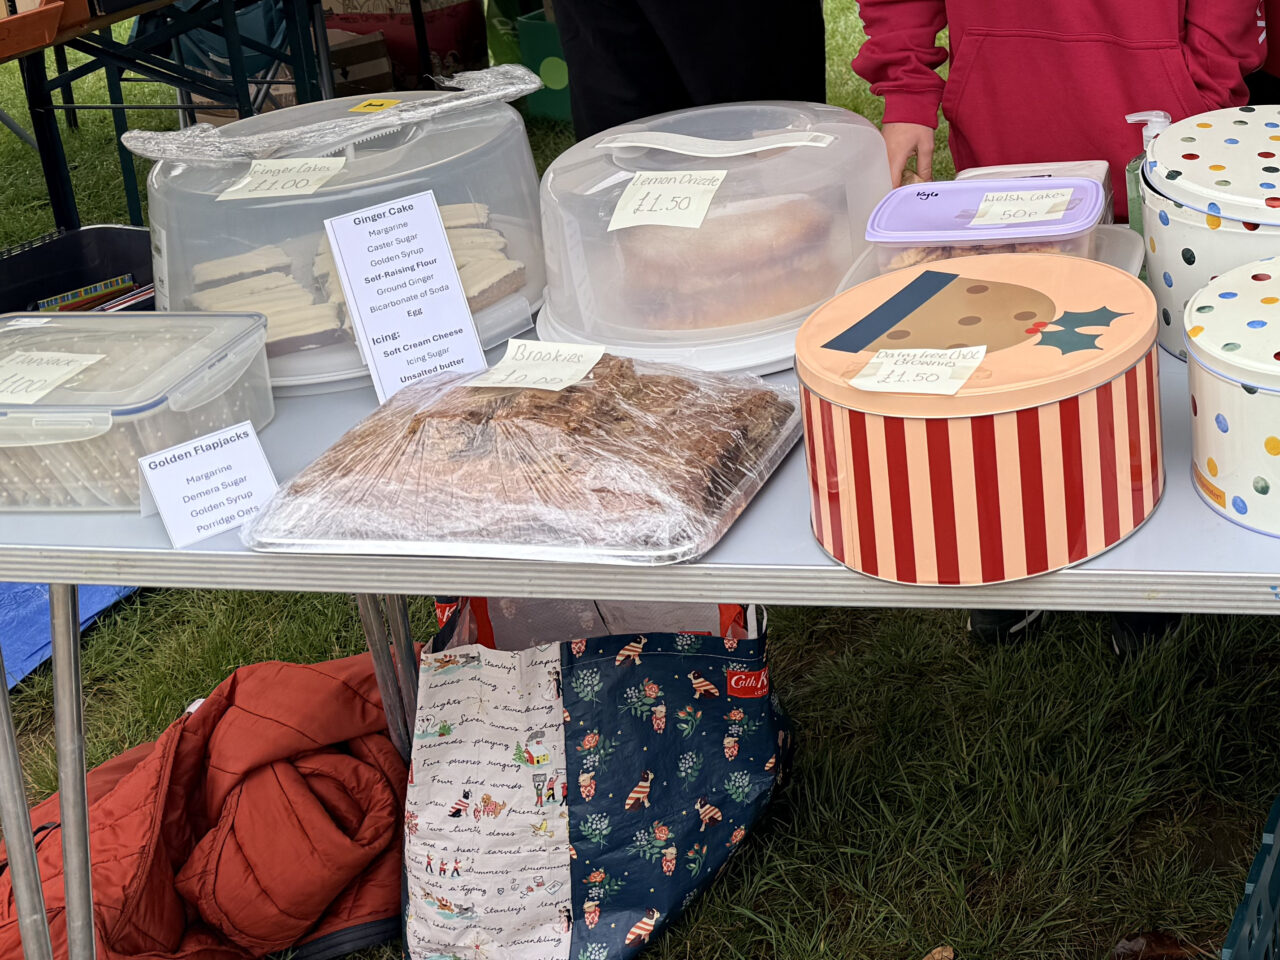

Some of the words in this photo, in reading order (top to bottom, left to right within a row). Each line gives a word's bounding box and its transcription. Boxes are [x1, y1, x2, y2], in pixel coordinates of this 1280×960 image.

[632, 173, 677, 187] Lemon
[353, 211, 387, 226] Ginger
[388, 203, 414, 216] Cake
[632, 191, 692, 215] £1.50
[368, 220, 409, 238] Margarine
[367, 239, 394, 253] Caster
[395, 232, 418, 246] Sugar
[370, 253, 400, 267] Golden
[400, 246, 425, 261] Syrup
[364, 263, 416, 285] Self-Raising
[416, 256, 438, 270] Flour
[376, 282, 407, 296] Ground
[408, 273, 434, 288] Ginger
[369, 293, 419, 314] Bicarbonate
[419, 289, 428, 299] of
[428, 283, 450, 297] Soda
[406, 306, 424, 318] Egg
[371, 330, 400, 346] Icing:
[383, 346, 402, 358] Soft
[402, 337, 431, 353] Cream
[432, 327, 464, 343] Cheese
[406, 353, 427, 366] Icing
[427, 345, 450, 360] Sugar
[512, 343, 584, 364] Brookies
[399, 365, 438, 384] Unsalted
[439, 356, 465, 371] butter
[877, 369, 940, 384] £1.50
[148, 449, 193, 471] Golden
[193, 428, 250, 457] Flapjacks
[185, 462, 233, 485] Margarine
[182, 485, 220, 504] Demera
[220, 474, 248, 493] Sugar
[190, 499, 226, 519] Golden
[226, 489, 253, 508] Syrup
[196, 511, 237, 534] Porridge
[236, 503, 260, 520] Oats
[731, 674, 757, 688] Cath
